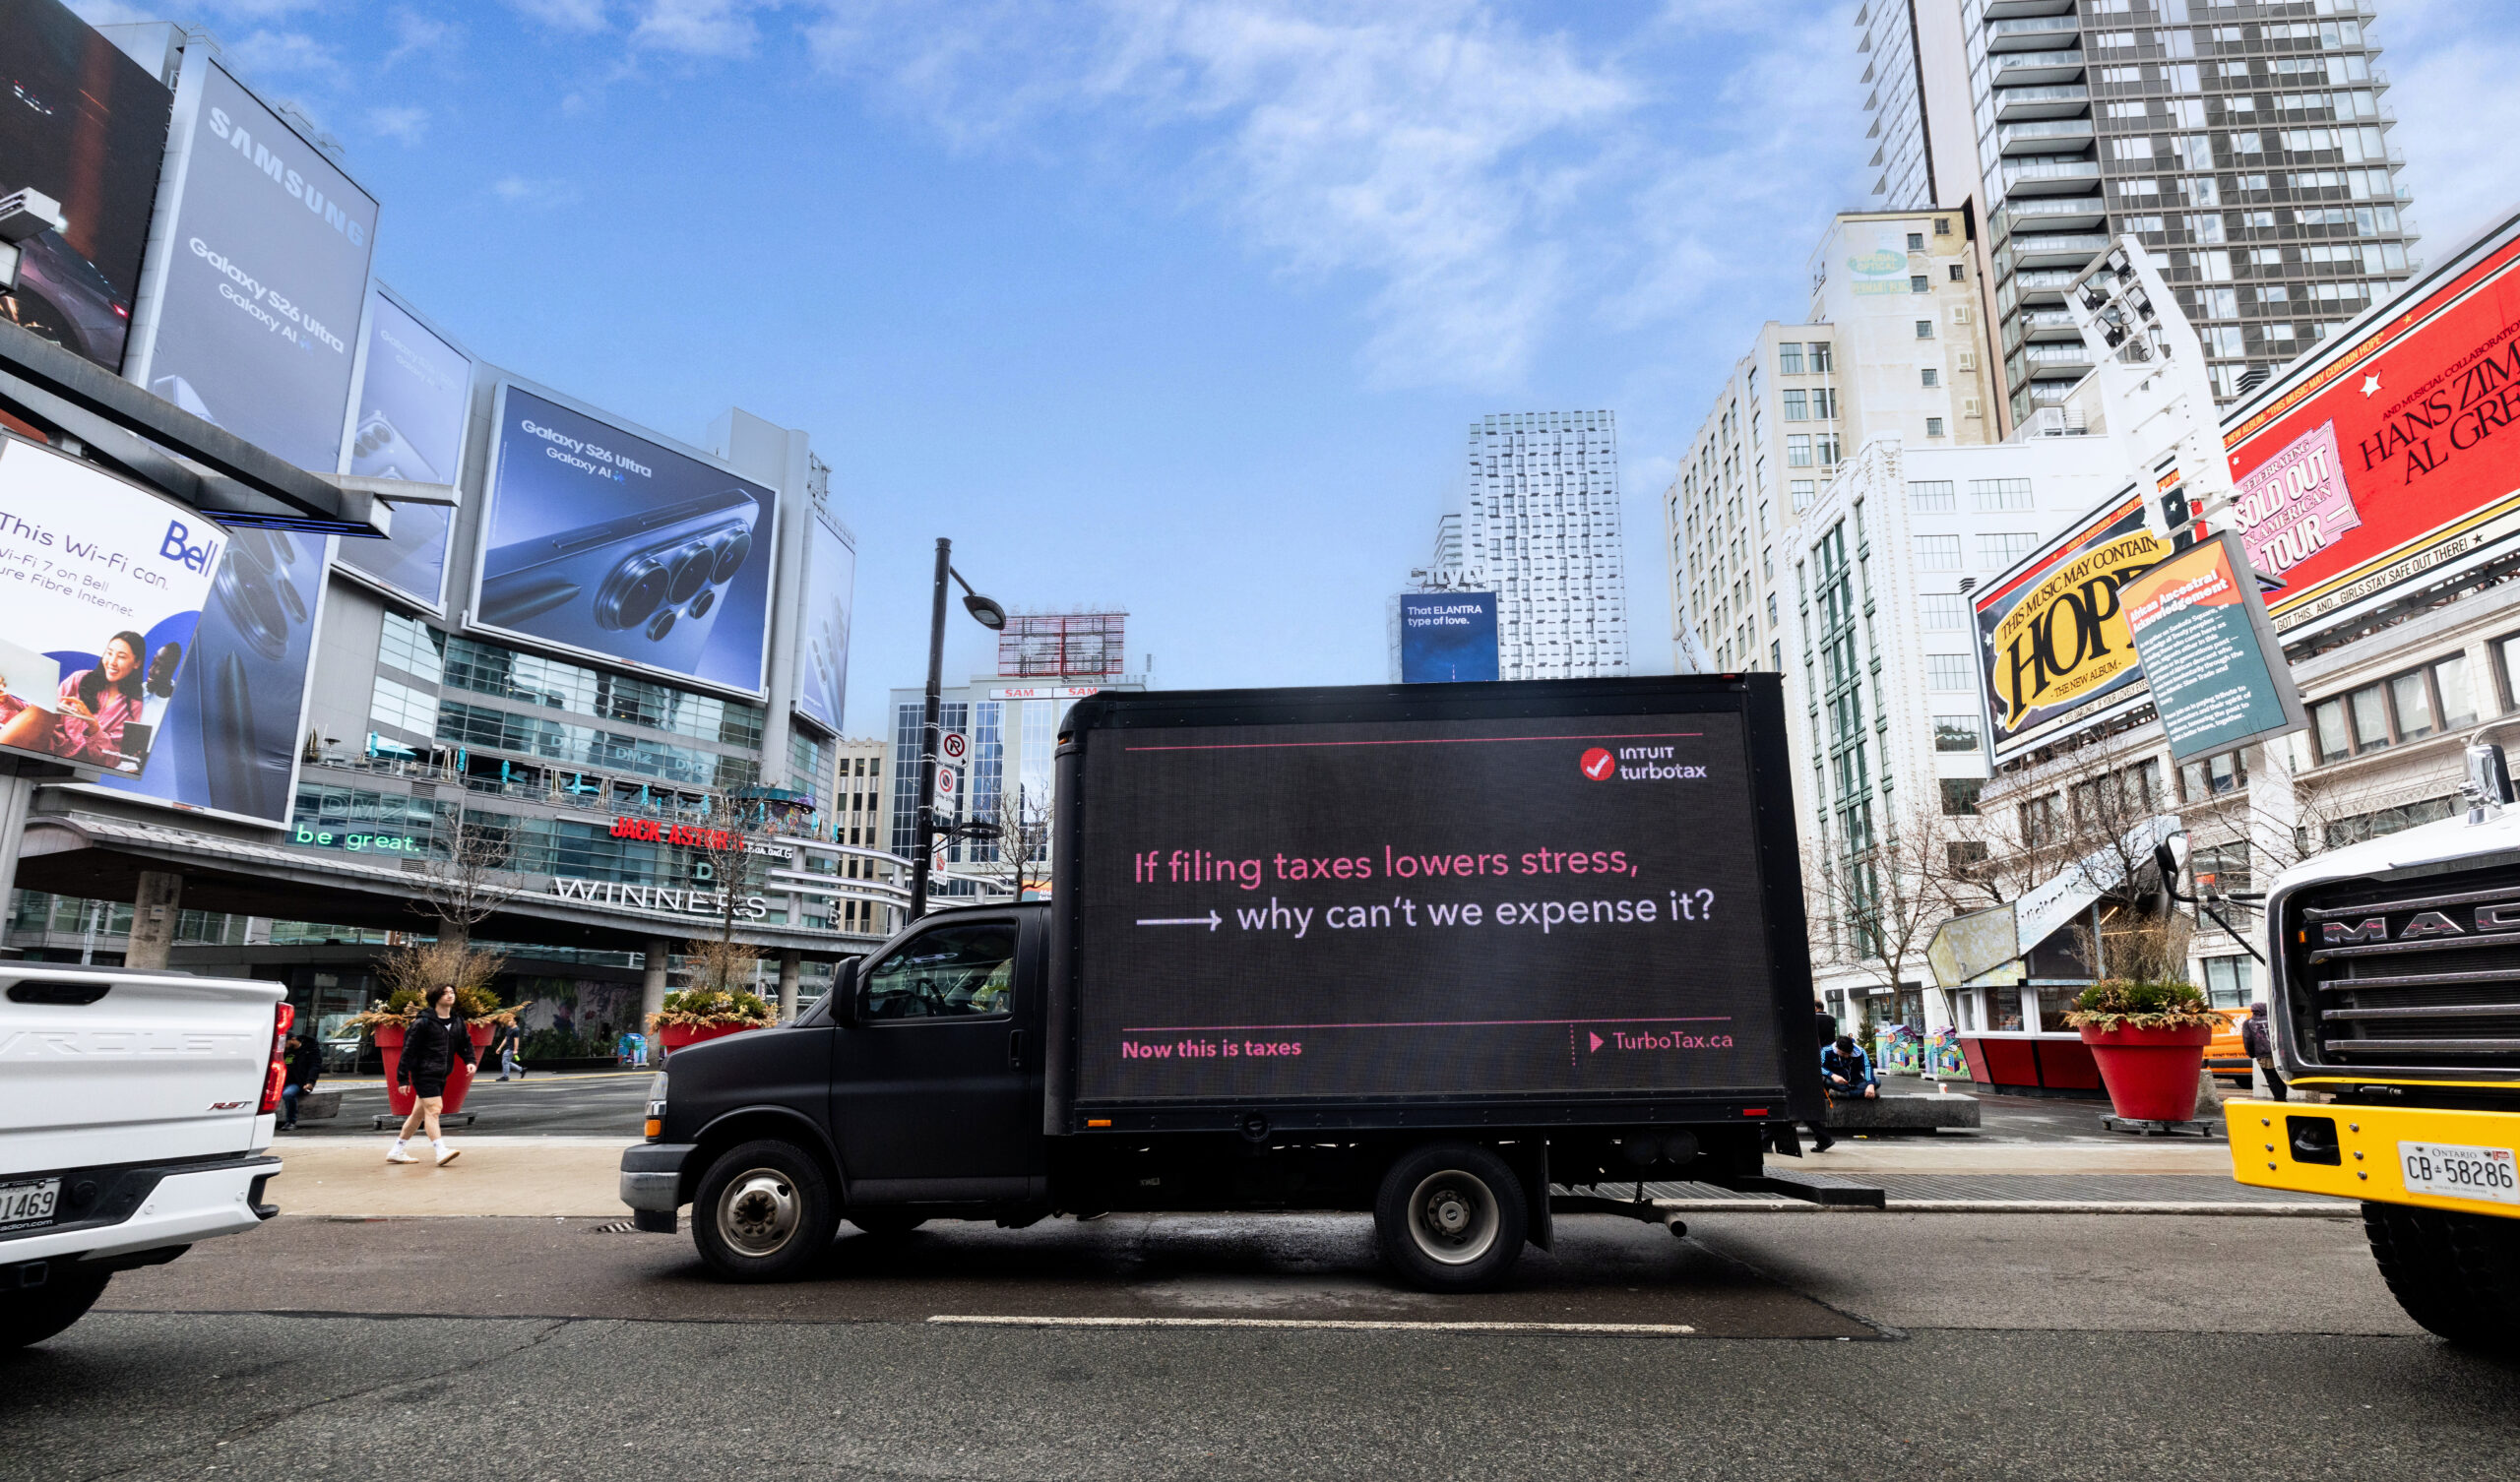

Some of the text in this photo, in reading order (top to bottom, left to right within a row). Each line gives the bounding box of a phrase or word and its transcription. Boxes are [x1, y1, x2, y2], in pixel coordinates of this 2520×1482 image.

[209, 106, 364, 247] SAMSUNG
[189, 237, 345, 354] Galaxy S26 Ultra
[219, 282, 297, 344] Galaxy AI
[2228, 427, 2241, 444] NEW
[2286, 385, 2308, 407] MUSIC
[2309, 372, 2325, 390] MAY
[2325, 351, 2359, 379] CONTAIN
[2382, 402, 2401, 421] AND
[521, 419, 652, 478] Galaxy S26 Ultra
[2359, 389, 2452, 472] HANS
[2405, 380, 2520, 485] AL GRE
[546, 447, 611, 478] Galaxy AI
[2240, 439, 2309, 493] CELEBRATING
[2234, 444, 2330, 535] SOLD OUT
[2259, 481, 2333, 540] AMERICAN
[0, 511, 169, 590] This Wi-Fi can.
[158, 519, 219, 578] Bell
[2260, 514, 2327, 576] TOUR
[31, 574, 73, 595] Fibre
[43, 560, 53, 571] 7
[57, 569, 78, 582] on
[83, 575, 109, 592] Bell
[2001, 534, 2160, 640] THIS MUSIC MAY CONTAIN
[2130, 569, 2219, 623] African Ancestral
[2277, 619, 2292, 631] GOT
[2340, 587, 2365, 603] GIRLS
[2365, 577, 2387, 592] STAY
[2388, 567, 2411, 582] SAFE
[2413, 556, 2431, 572] OUT
[2432, 537, 2468, 562] THERE!
[1408, 604, 1482, 615] That ELANTRA
[1408, 616, 1470, 627] type of love.
[2132, 578, 2229, 634] Acknowledgement
[1005, 689, 1035, 698] SAM
[1068, 687, 1098, 696] SAM
[2054, 659, 2117, 698] THE NEW ALBUM
[615, 747, 653, 765] DMZ
[1619, 746, 1674, 760] INTUIT
[1619, 761, 1707, 780] turbotax
[296, 824, 420, 852] be great.
[610, 816, 745, 851] JACK ASTORS
[1135, 844, 1638, 890] If filing taxes lowers stress,
[552, 876, 767, 919] WINNERS
[1236, 889, 1715, 939] why can't we expense it?
[2322, 902, 2520, 945] MAC
[1122, 1039, 1302, 1059] Now this is taxes
[1613, 1030, 1733, 1051] TurboTax.ca
[2432, 1147, 2478, 1158] ONTARIO
[0, 1191, 54, 1220] 1469
